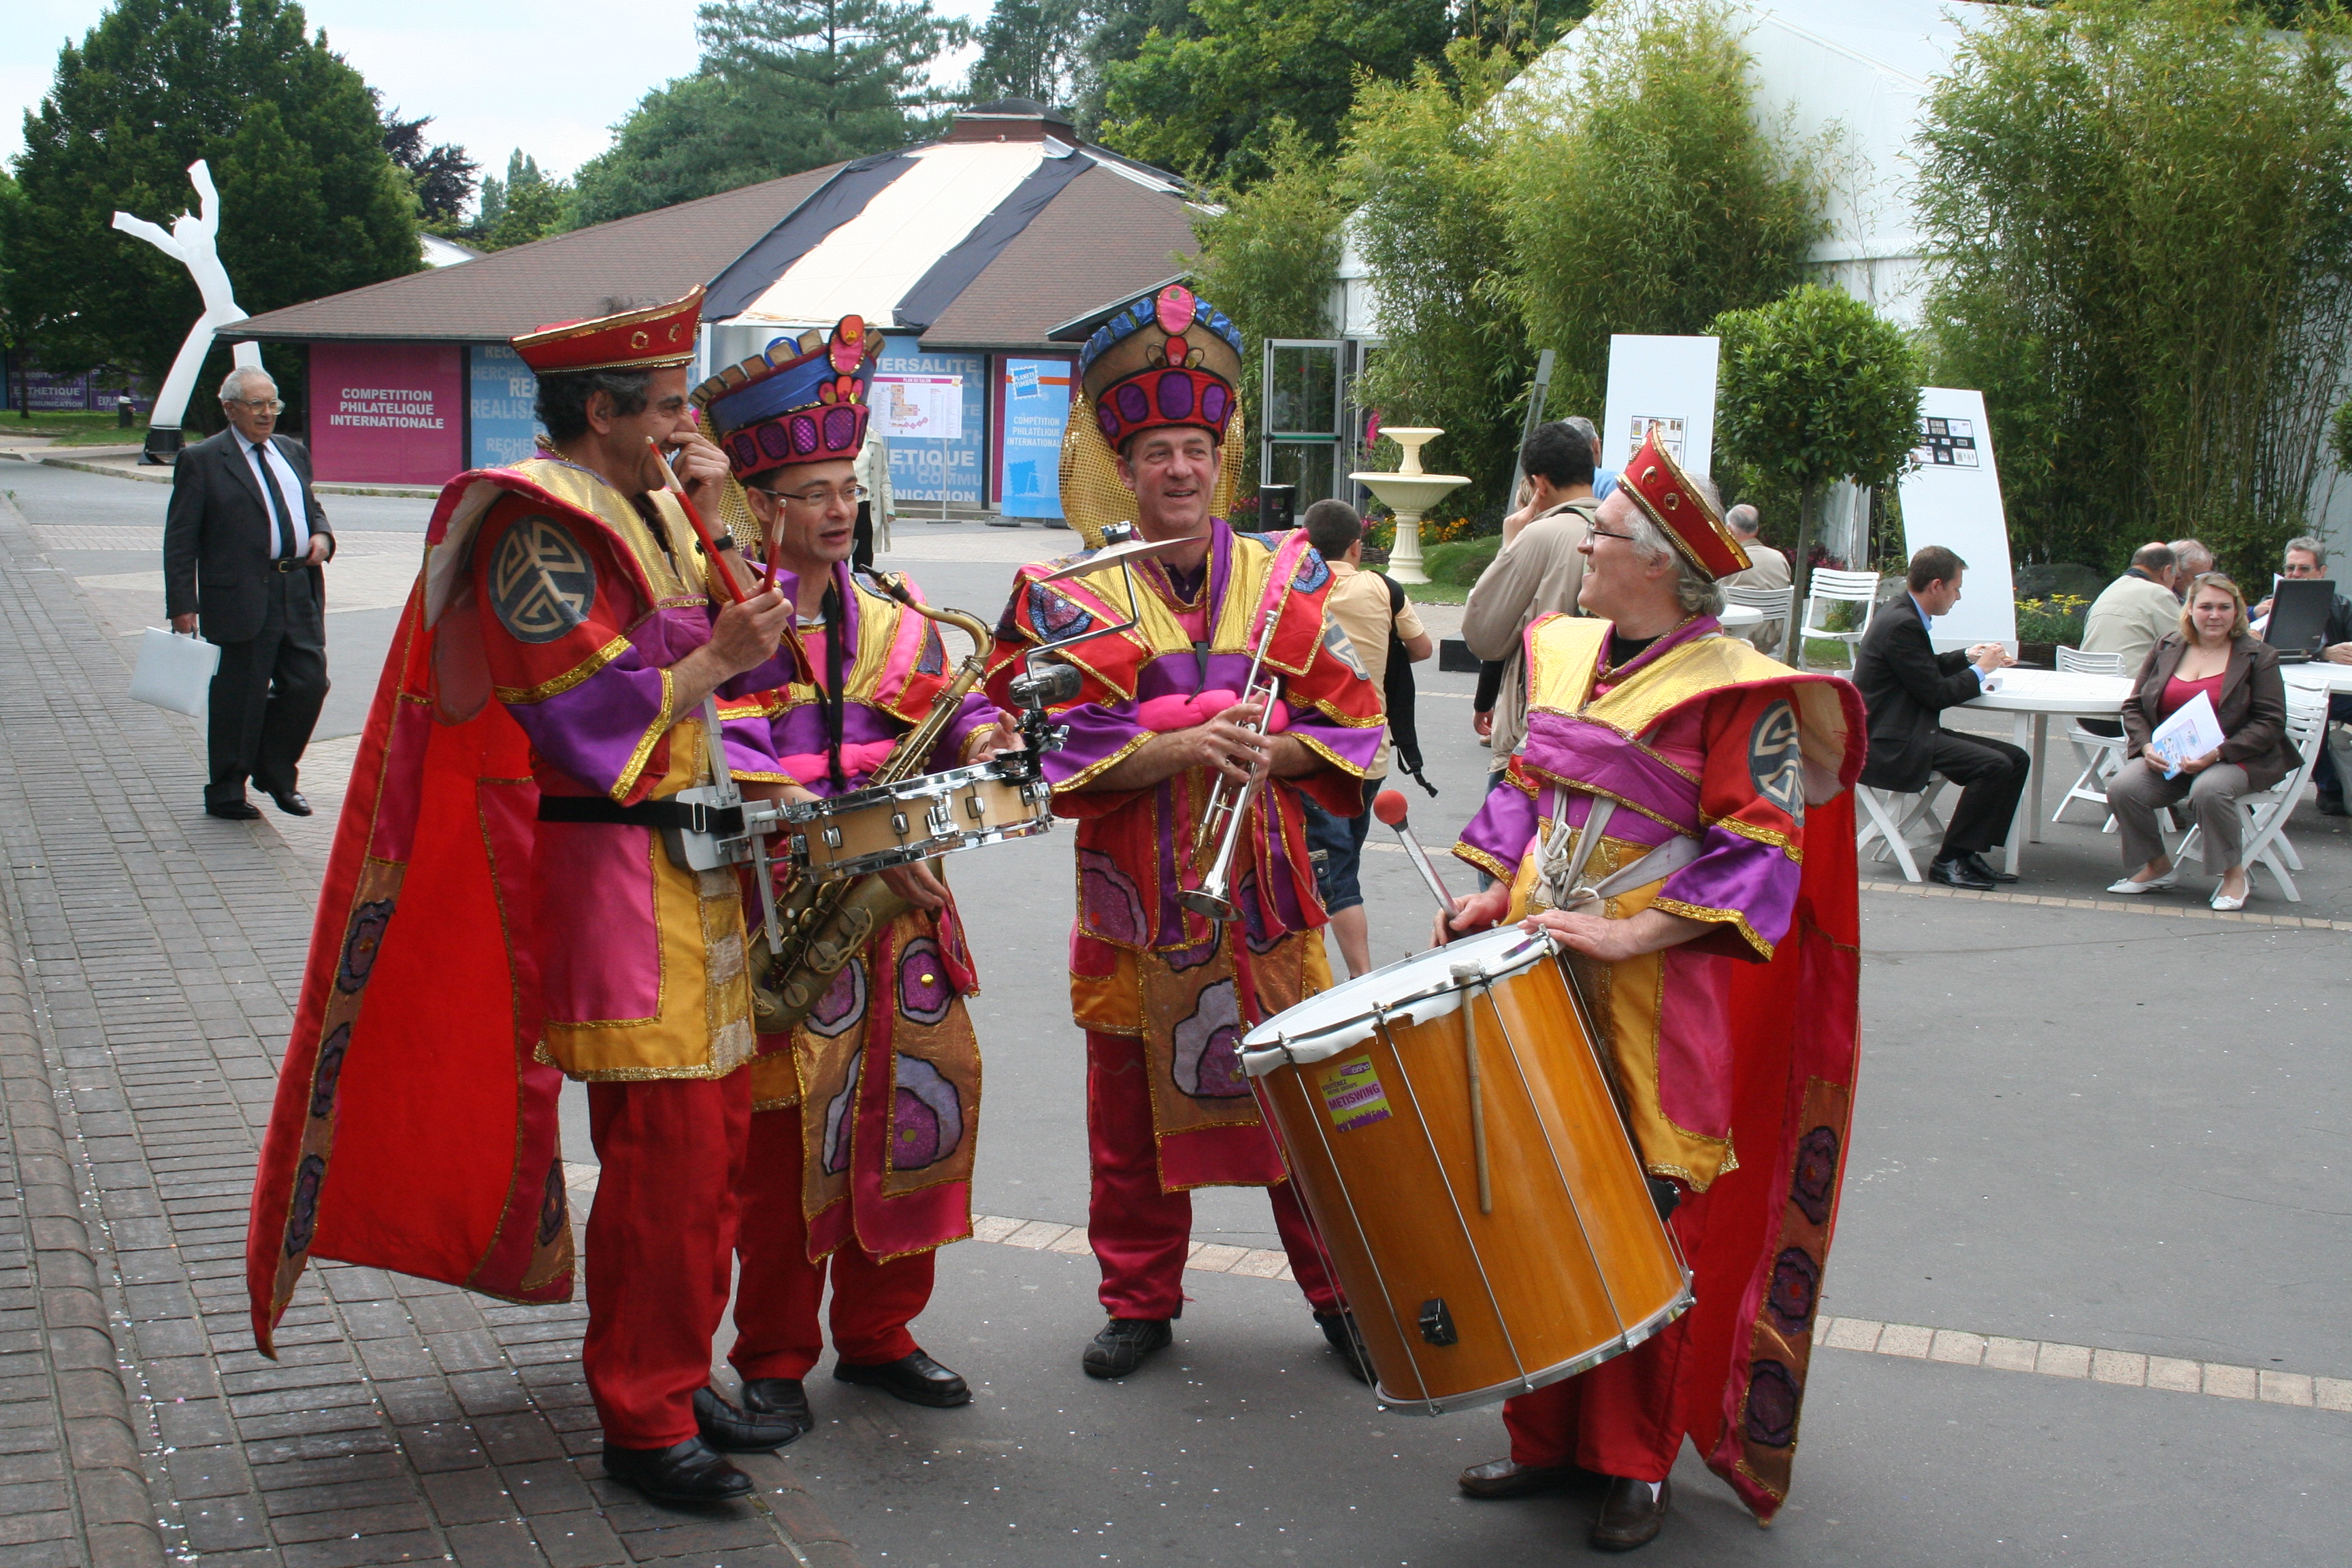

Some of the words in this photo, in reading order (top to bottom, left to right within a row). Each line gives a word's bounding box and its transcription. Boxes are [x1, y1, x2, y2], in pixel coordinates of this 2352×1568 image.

[1015, 377, 1037, 389] TIMBRE
[14, 387, 80, 396] ETHETIQUE
[342, 387, 433, 402] COMPETITION
[17, 399, 84, 408] CMMUNICATION
[340, 402, 434, 416] PHILATELIQUE
[330, 414, 444, 429] INTERNATIONALE
[889, 449, 975, 467] ETIQUE
[1328, 1083, 1380, 1111] METISWING
